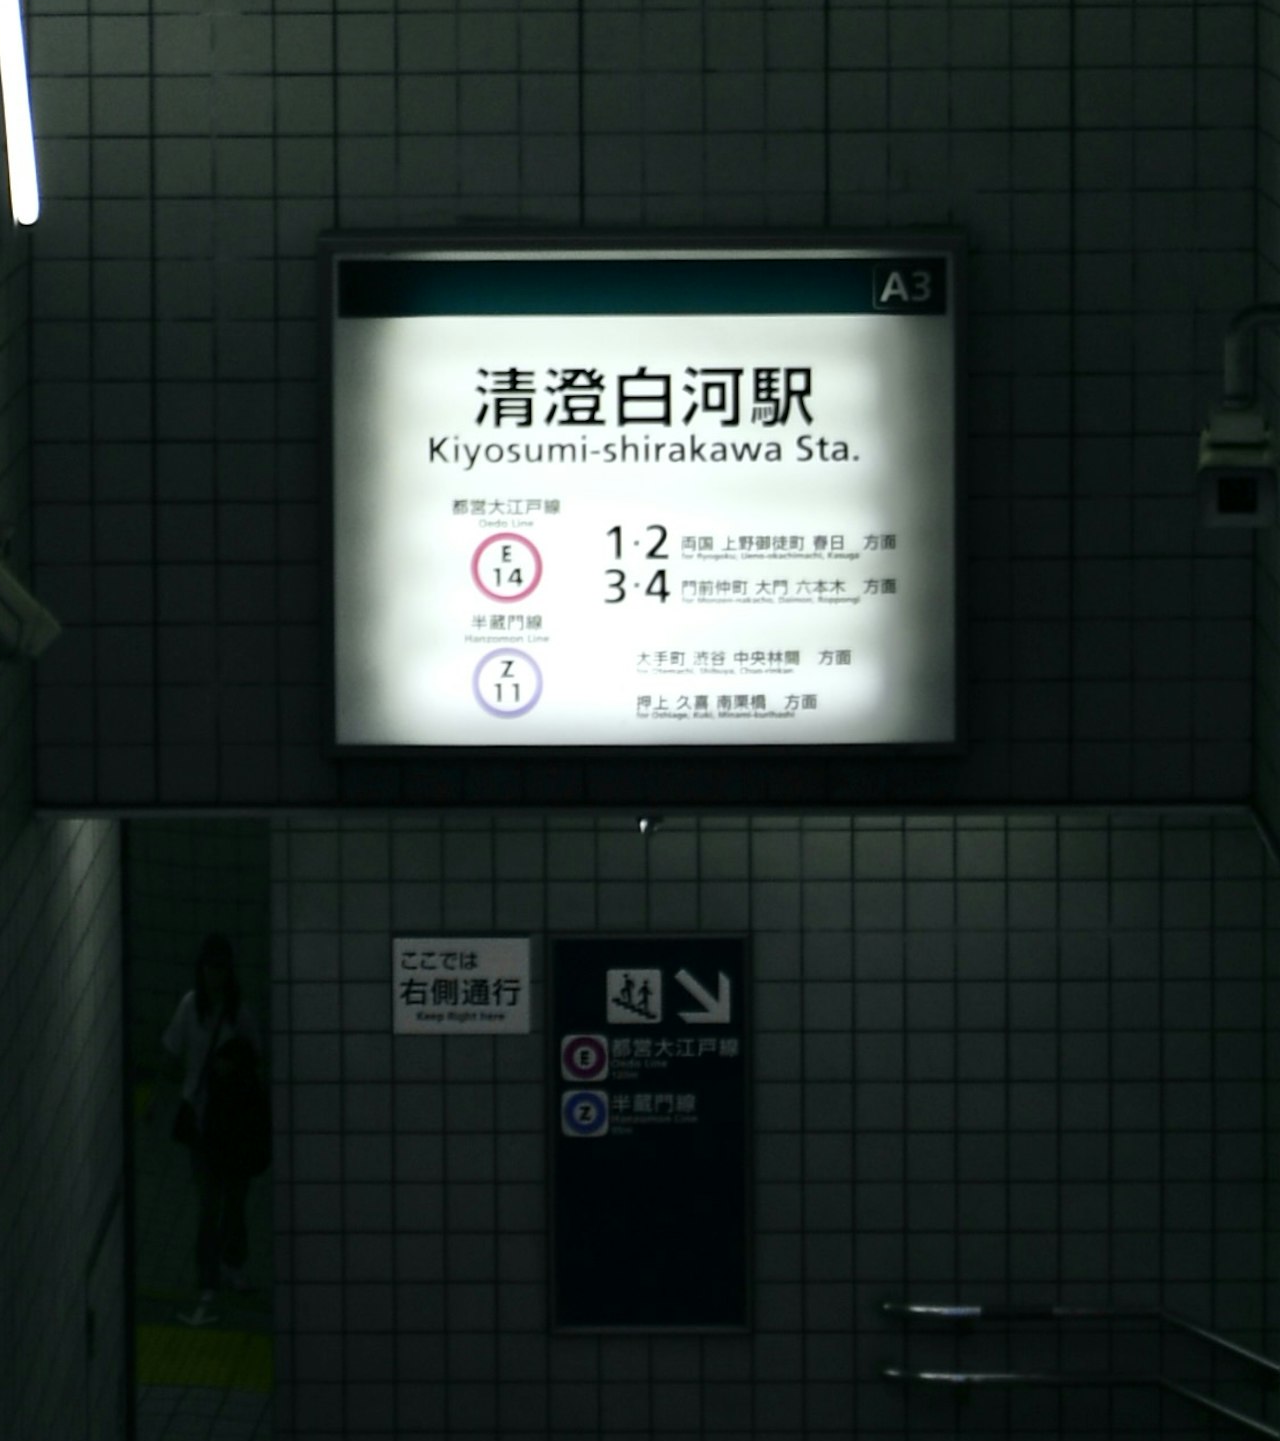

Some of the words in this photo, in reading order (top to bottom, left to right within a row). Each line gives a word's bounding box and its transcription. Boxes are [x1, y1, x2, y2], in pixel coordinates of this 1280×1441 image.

[879, 271, 932, 303] A3
[475, 365, 814, 428] 清澄白河駅
[428, 434, 782, 471] Kiyosumi-shirakawa
[795, 435, 860, 462] Sta.
[452, 498, 561, 516] 都営大江戸線
[512, 519, 534, 528] Line
[681, 535, 714, 551] 両国
[721, 535, 805, 551] 上野御徒町
[813, 535, 845, 551] 春日
[863, 533, 897, 551] 方面
[501, 544, 512, 563] E
[492, 567, 524, 588] 14
[681, 579, 748, 596] 門前仲町
[755, 579, 789, 596] 大門
[796, 579, 846, 596] 六本木
[863, 578, 897, 595] 方面
[470, 614, 543, 631] 半蔵門線
[527, 634, 550, 644] Line
[636, 650, 686, 667] 大手町
[693, 650, 727, 667] 渋谷
[733, 650, 801, 667] 中央林間
[817, 649, 852, 667] 方面
[500, 659, 515, 679] Z
[493, 682, 521, 703] 11
[636, 694, 669, 711] 押上
[676, 694, 709, 711] 久喜
[716, 694, 767, 711] 南栗橋
[784, 693, 818, 711] 方面
[401, 951, 478, 970] ここでは
[399, 977, 521, 1006] 右側通行
[611, 1036, 740, 1058] 都営大江戸線
[580, 1051, 590, 1066] E
[611, 1091, 697, 1114] 半蔵門線
[579, 1106, 591, 1121] Z
